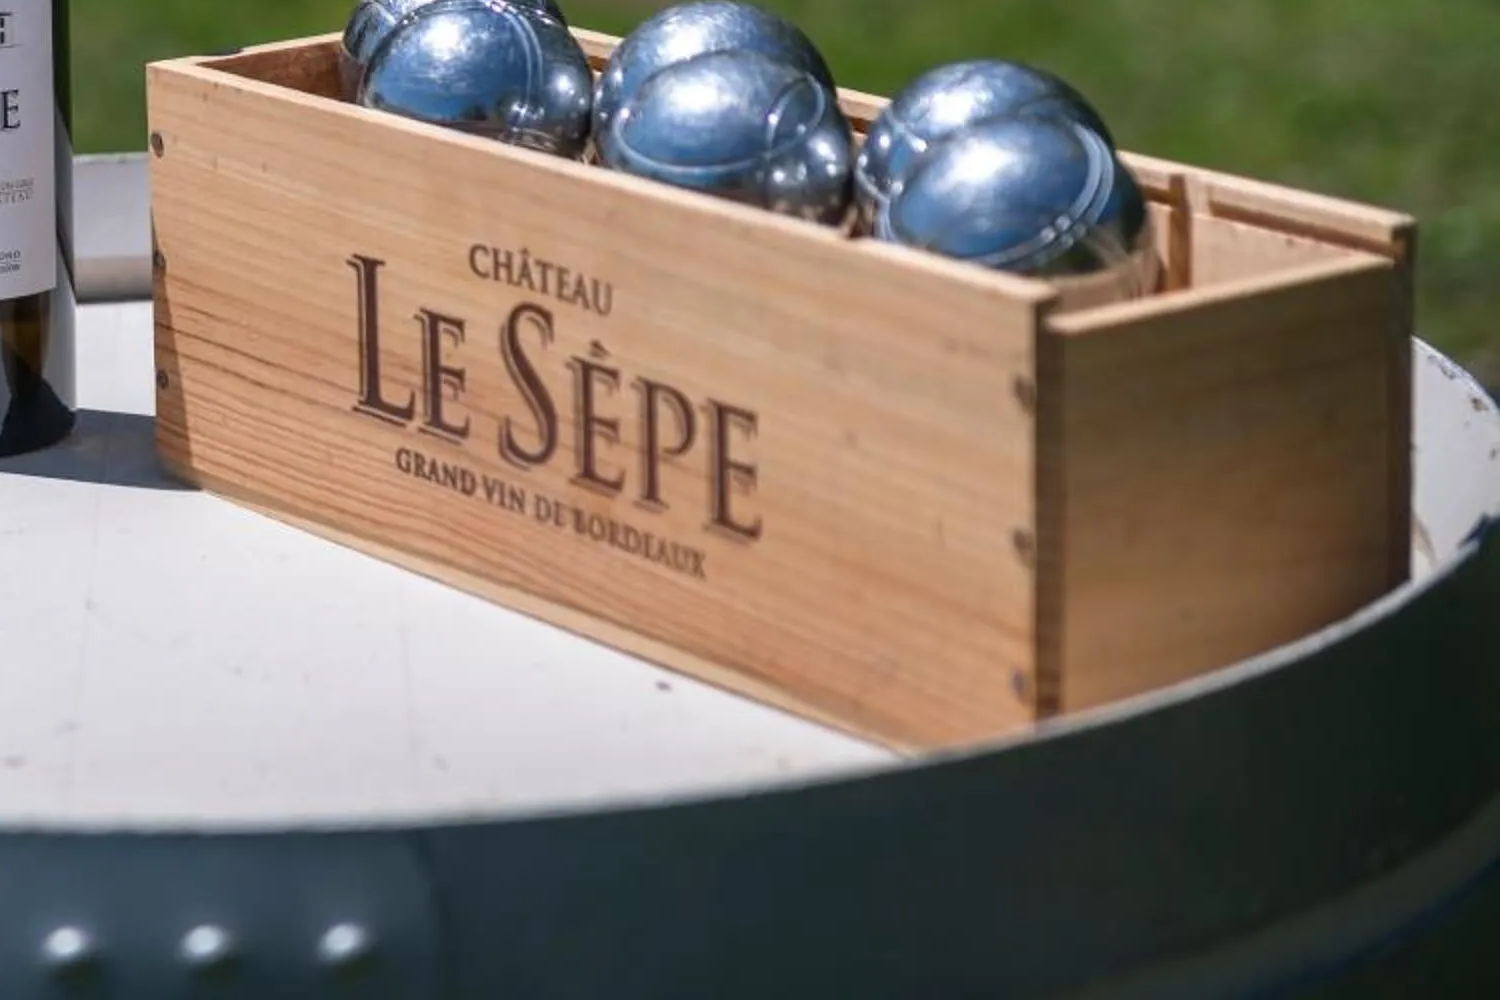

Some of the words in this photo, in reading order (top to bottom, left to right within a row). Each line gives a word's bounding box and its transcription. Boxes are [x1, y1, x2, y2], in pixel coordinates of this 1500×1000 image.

[467, 243, 614, 317] CHÂTEAU
[346, 252, 470, 446] LE
[395, 447, 478, 497] GRAND
[482, 474, 525, 514] VIN
[535, 495, 566, 528] DE
[572, 506, 706, 581] BORDEAUX
